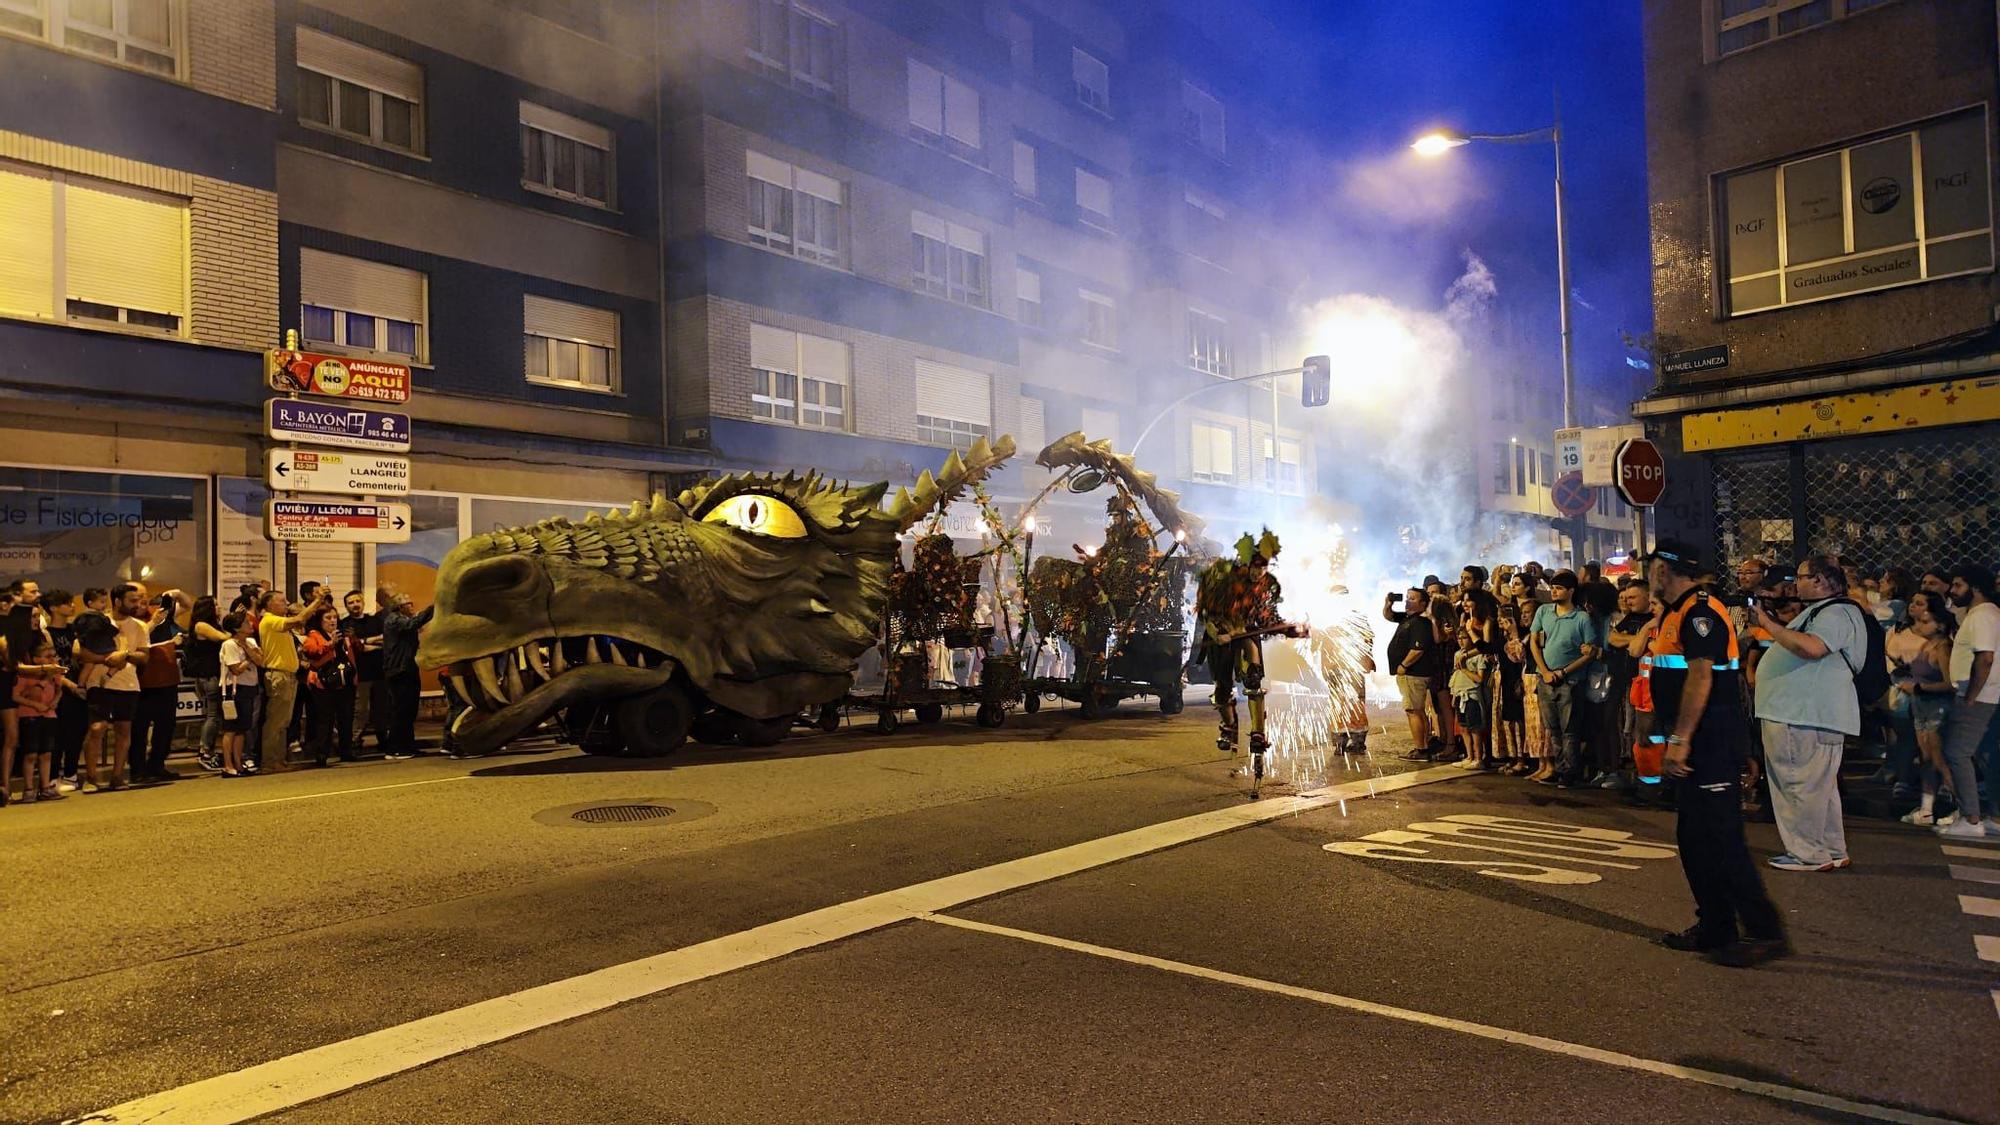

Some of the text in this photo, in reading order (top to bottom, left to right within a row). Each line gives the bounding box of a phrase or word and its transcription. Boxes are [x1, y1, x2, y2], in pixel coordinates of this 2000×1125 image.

[1793, 258, 1912, 289] Graduados Sociales
[1693, 356, 1725, 368] LLANEZA
[349, 362, 406, 377] ANÚNCIATE
[323, 375, 342, 383] NO
[351, 374, 403, 388] AQUÍ
[280, 408, 347, 427] R. BAYÓN
[1562, 453, 1579, 466] 19
[1623, 464, 1663, 480] STOP
[348, 480, 407, 491] Cementeriu
[318, 504, 353, 515] LLEÓN
[1322, 814, 1679, 885] STOP
